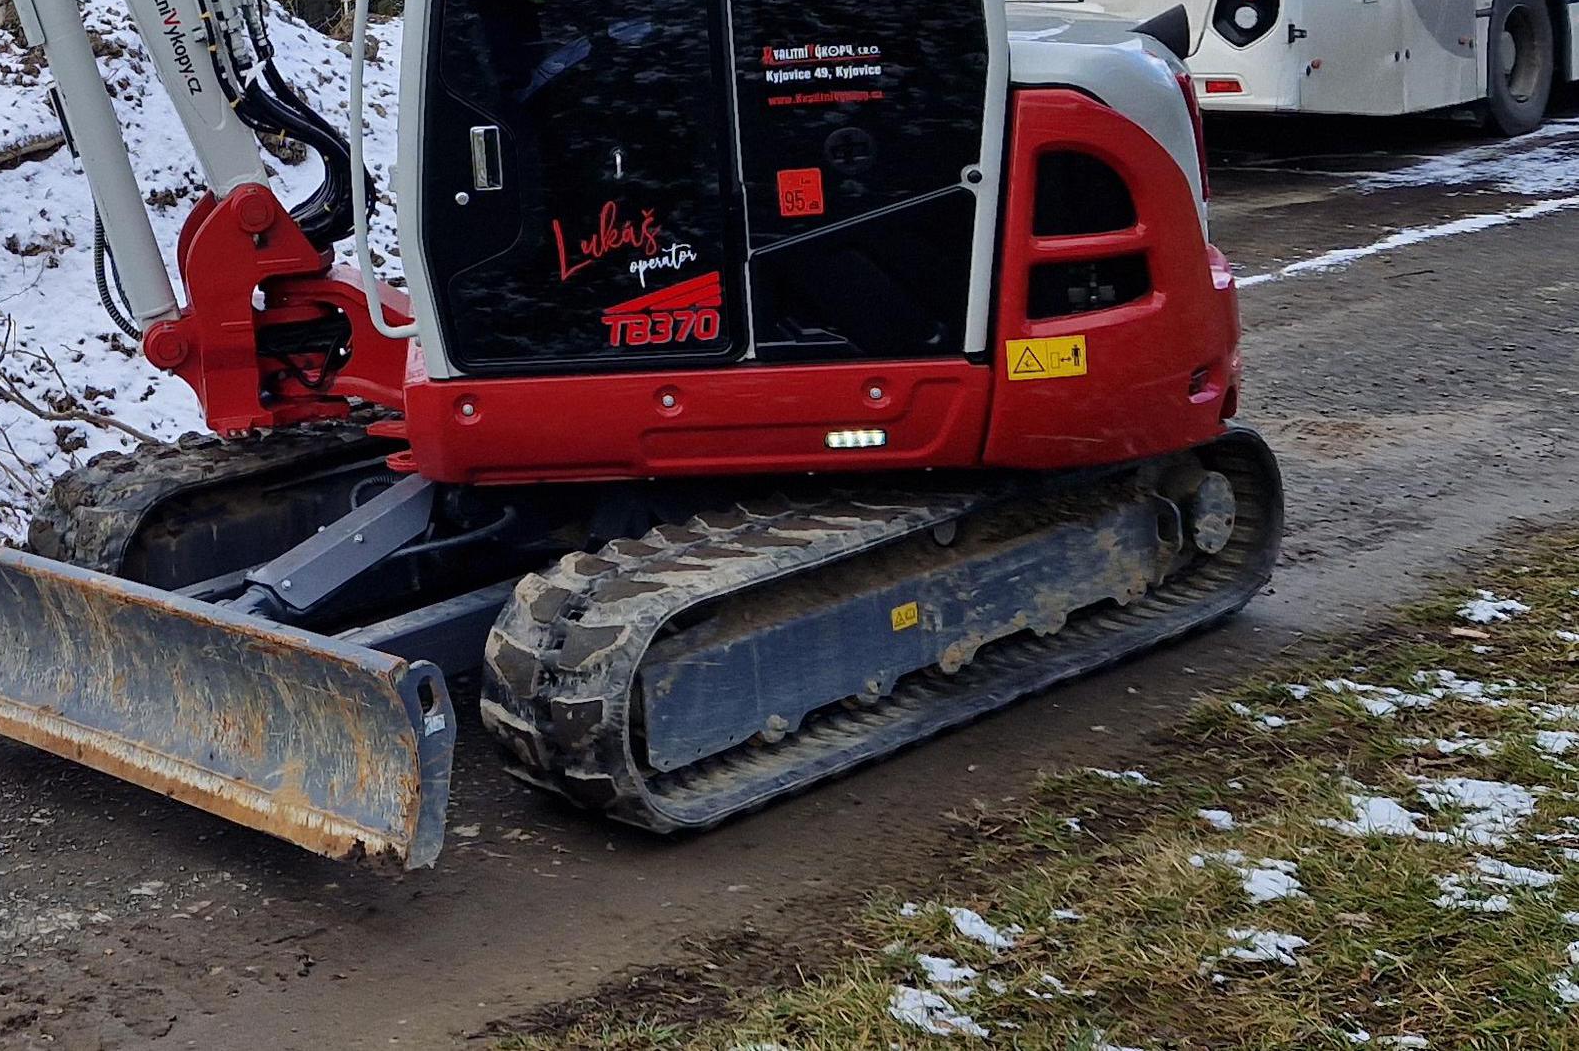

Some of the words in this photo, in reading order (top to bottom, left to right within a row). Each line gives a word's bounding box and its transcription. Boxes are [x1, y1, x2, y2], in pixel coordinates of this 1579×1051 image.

[765, 68, 812, 84] Kyjovice
[814, 66, 833, 80] 49,
[835, 63, 882, 79] Kyjovice
[784, 189, 806, 212] 95
[600, 308, 721, 347] TB370
